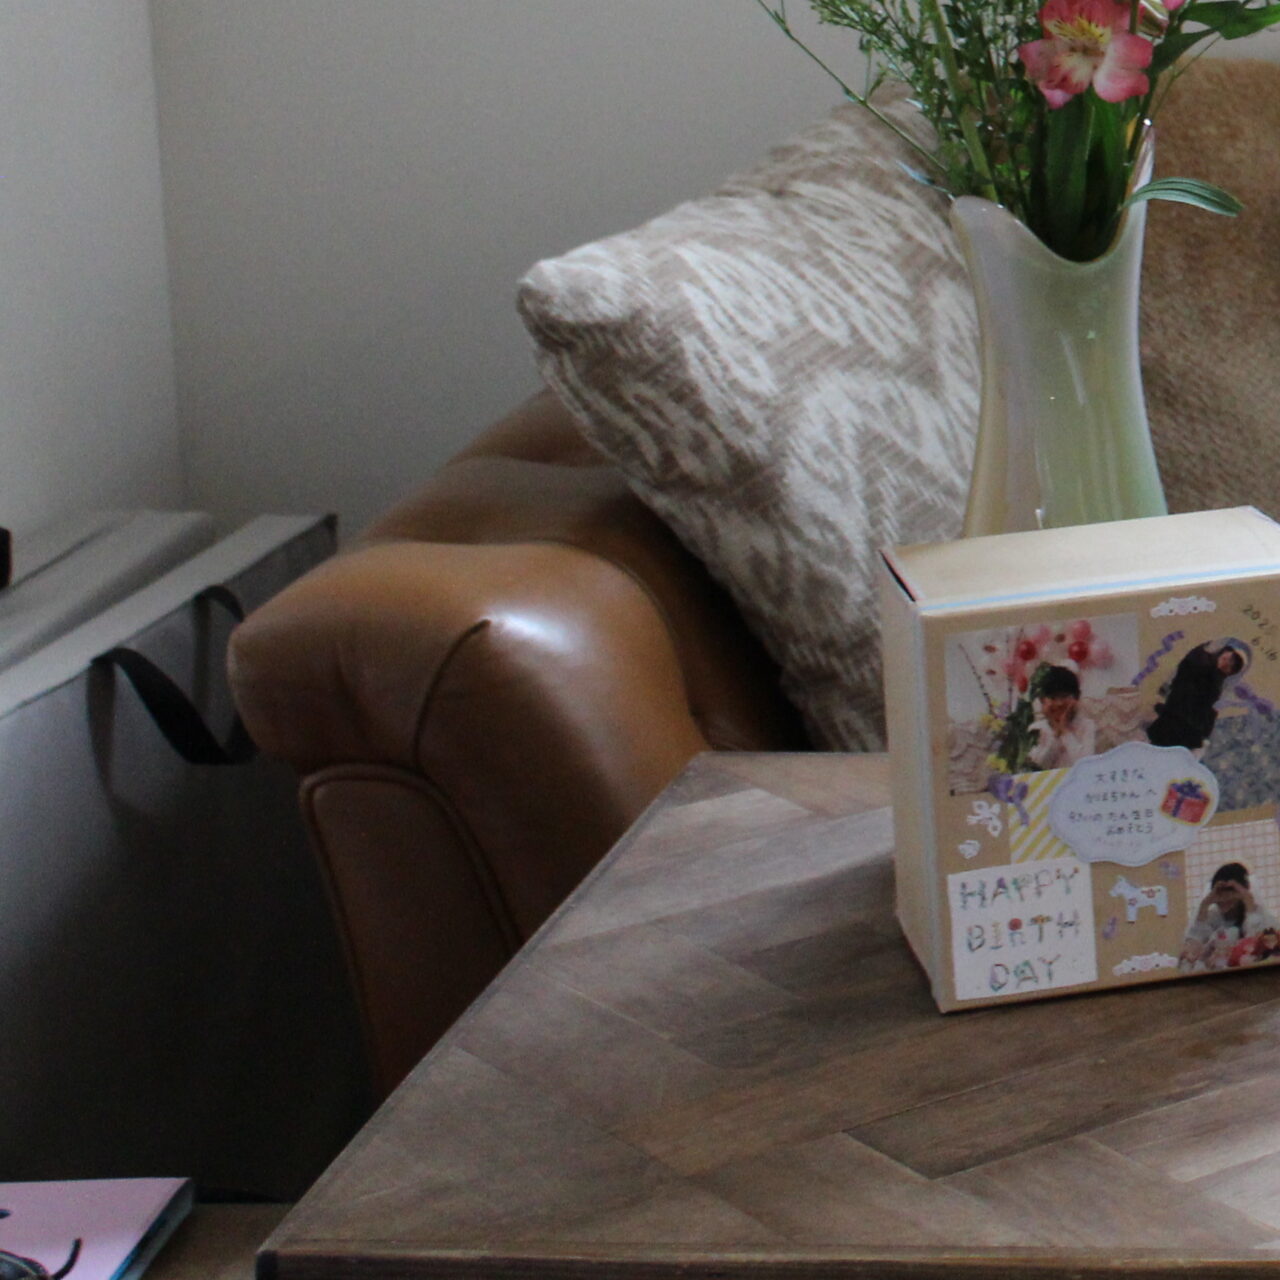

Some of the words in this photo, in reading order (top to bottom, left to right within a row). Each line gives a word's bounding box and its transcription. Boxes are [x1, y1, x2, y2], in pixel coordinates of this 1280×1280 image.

[959, 865, 1080, 910] HAPPY
[966, 908, 1081, 953] BIRTH
[988, 953, 1062, 992] DAY
